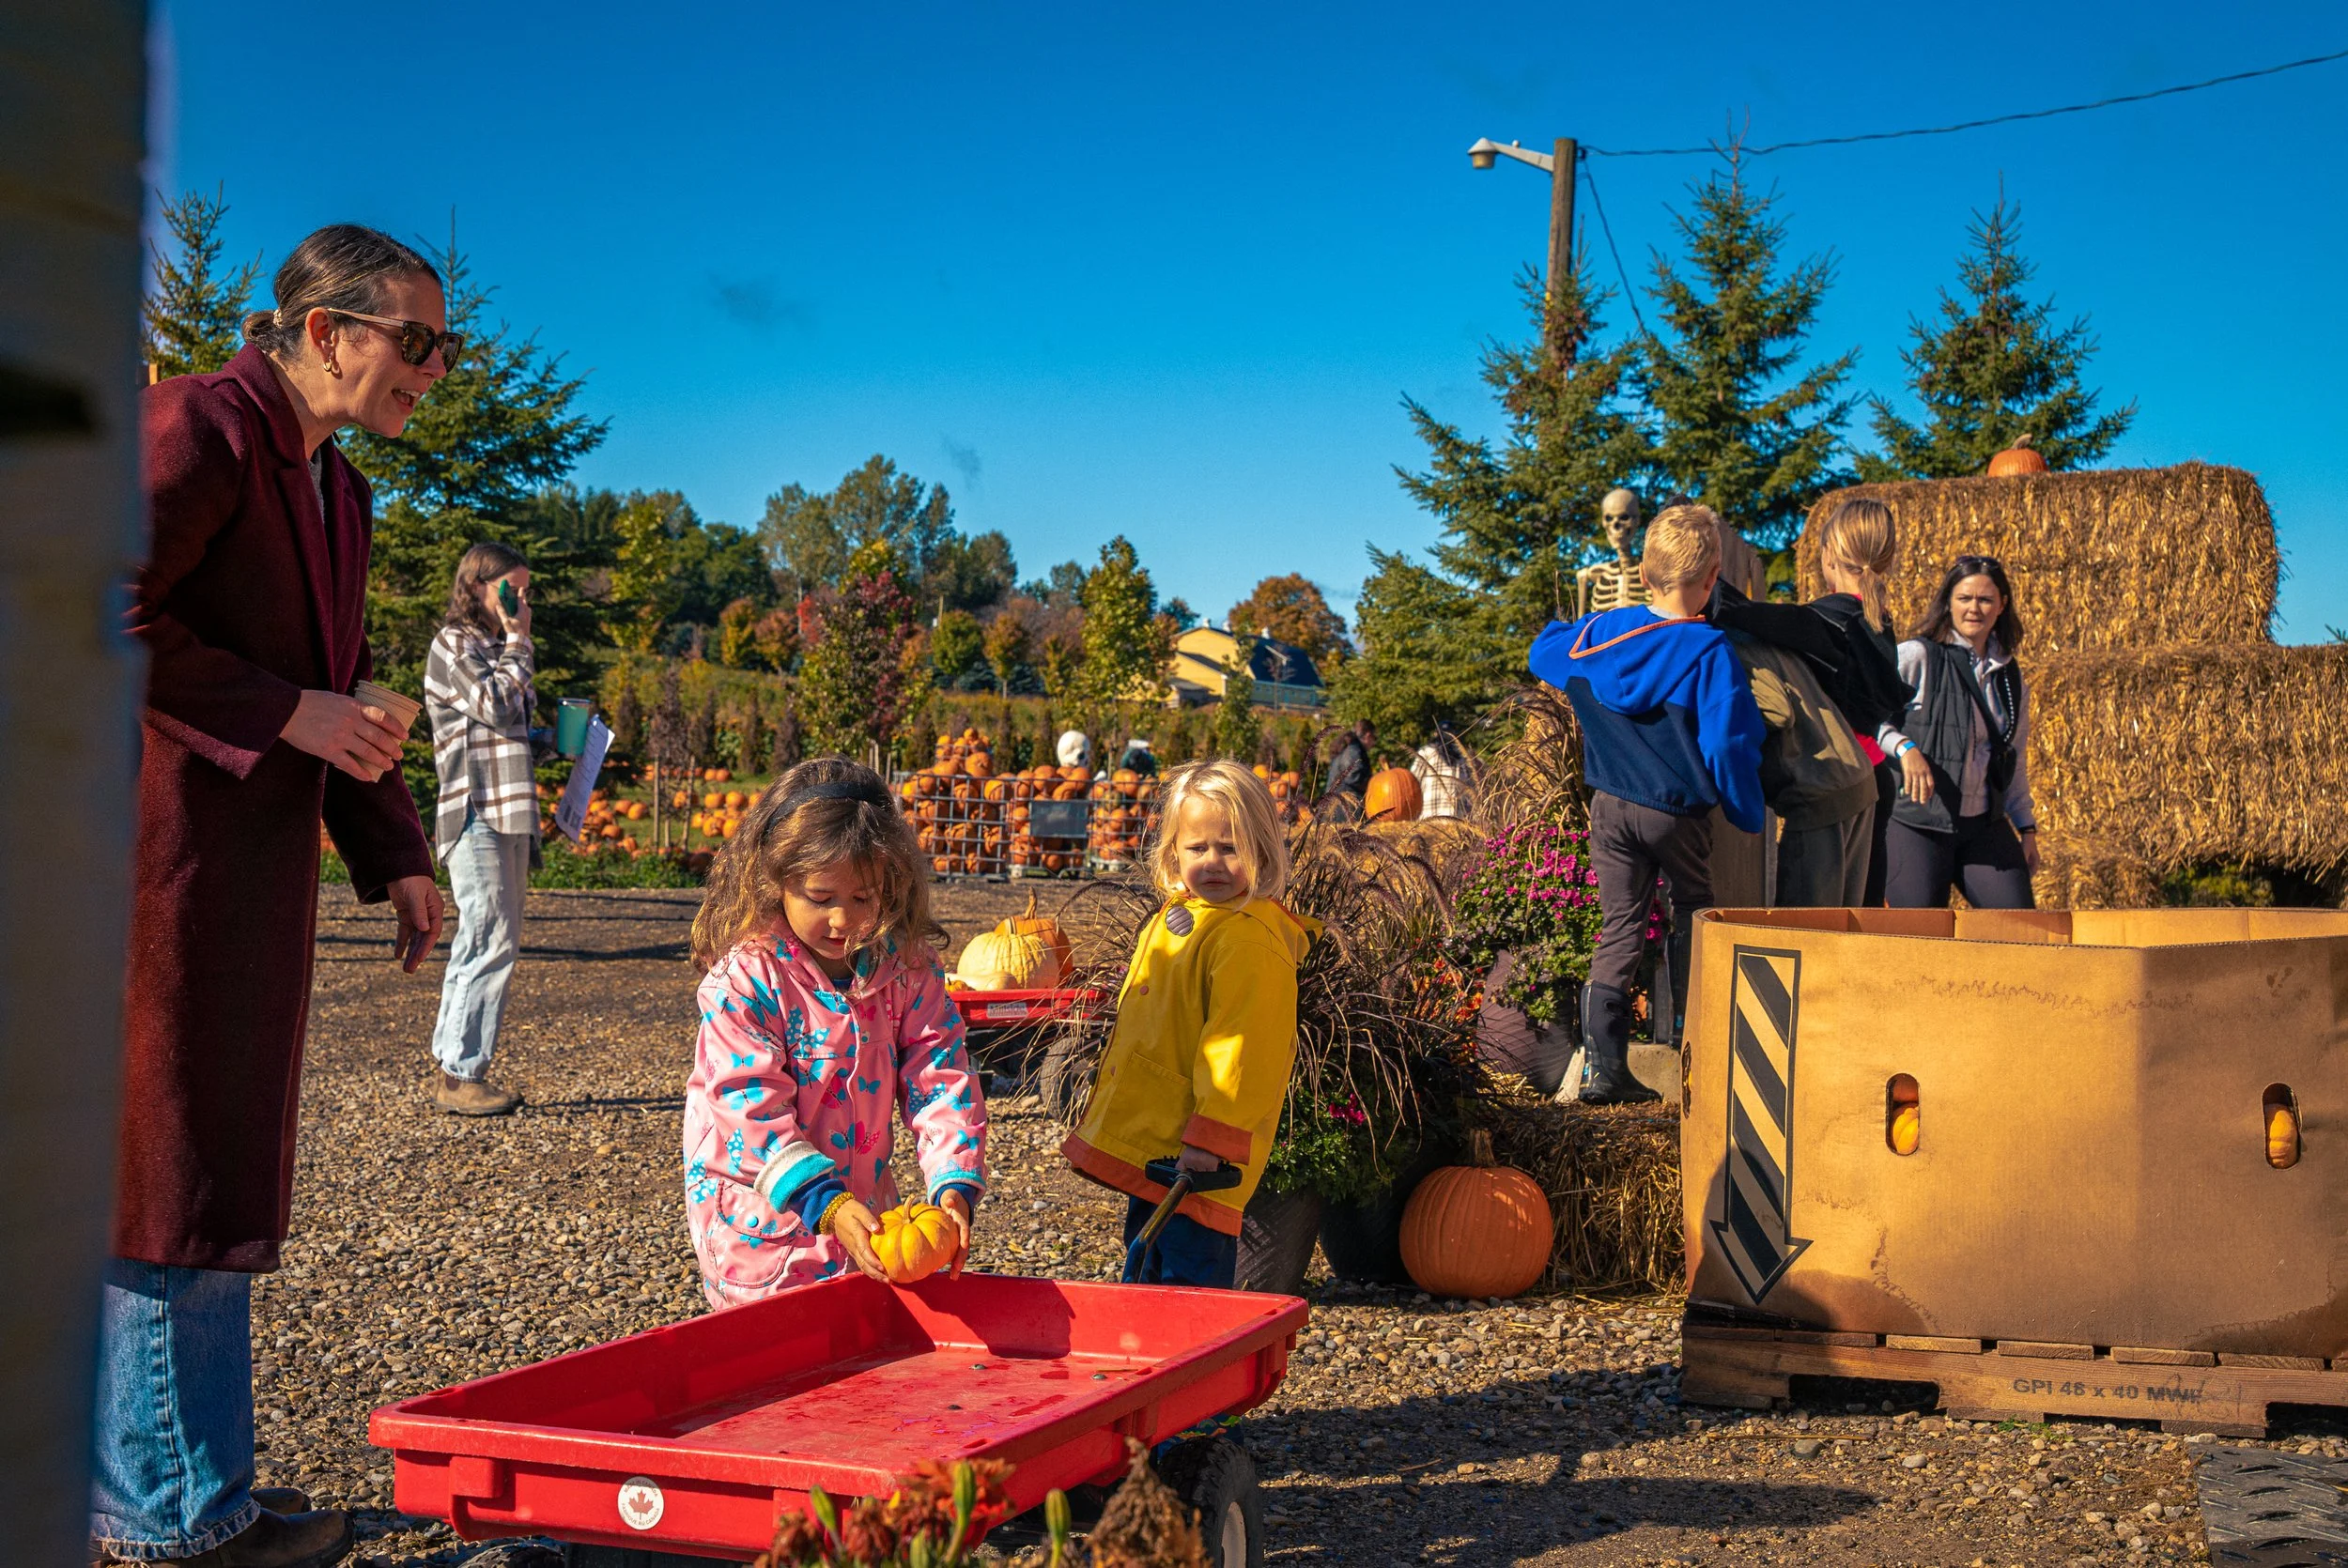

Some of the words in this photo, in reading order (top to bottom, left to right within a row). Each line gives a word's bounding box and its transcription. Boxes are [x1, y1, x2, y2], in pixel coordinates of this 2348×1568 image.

[2013, 1378, 2052, 1395] GPI
[2113, 1385, 2139, 1399] 40
[646, 1508, 659, 1524] CANADA
